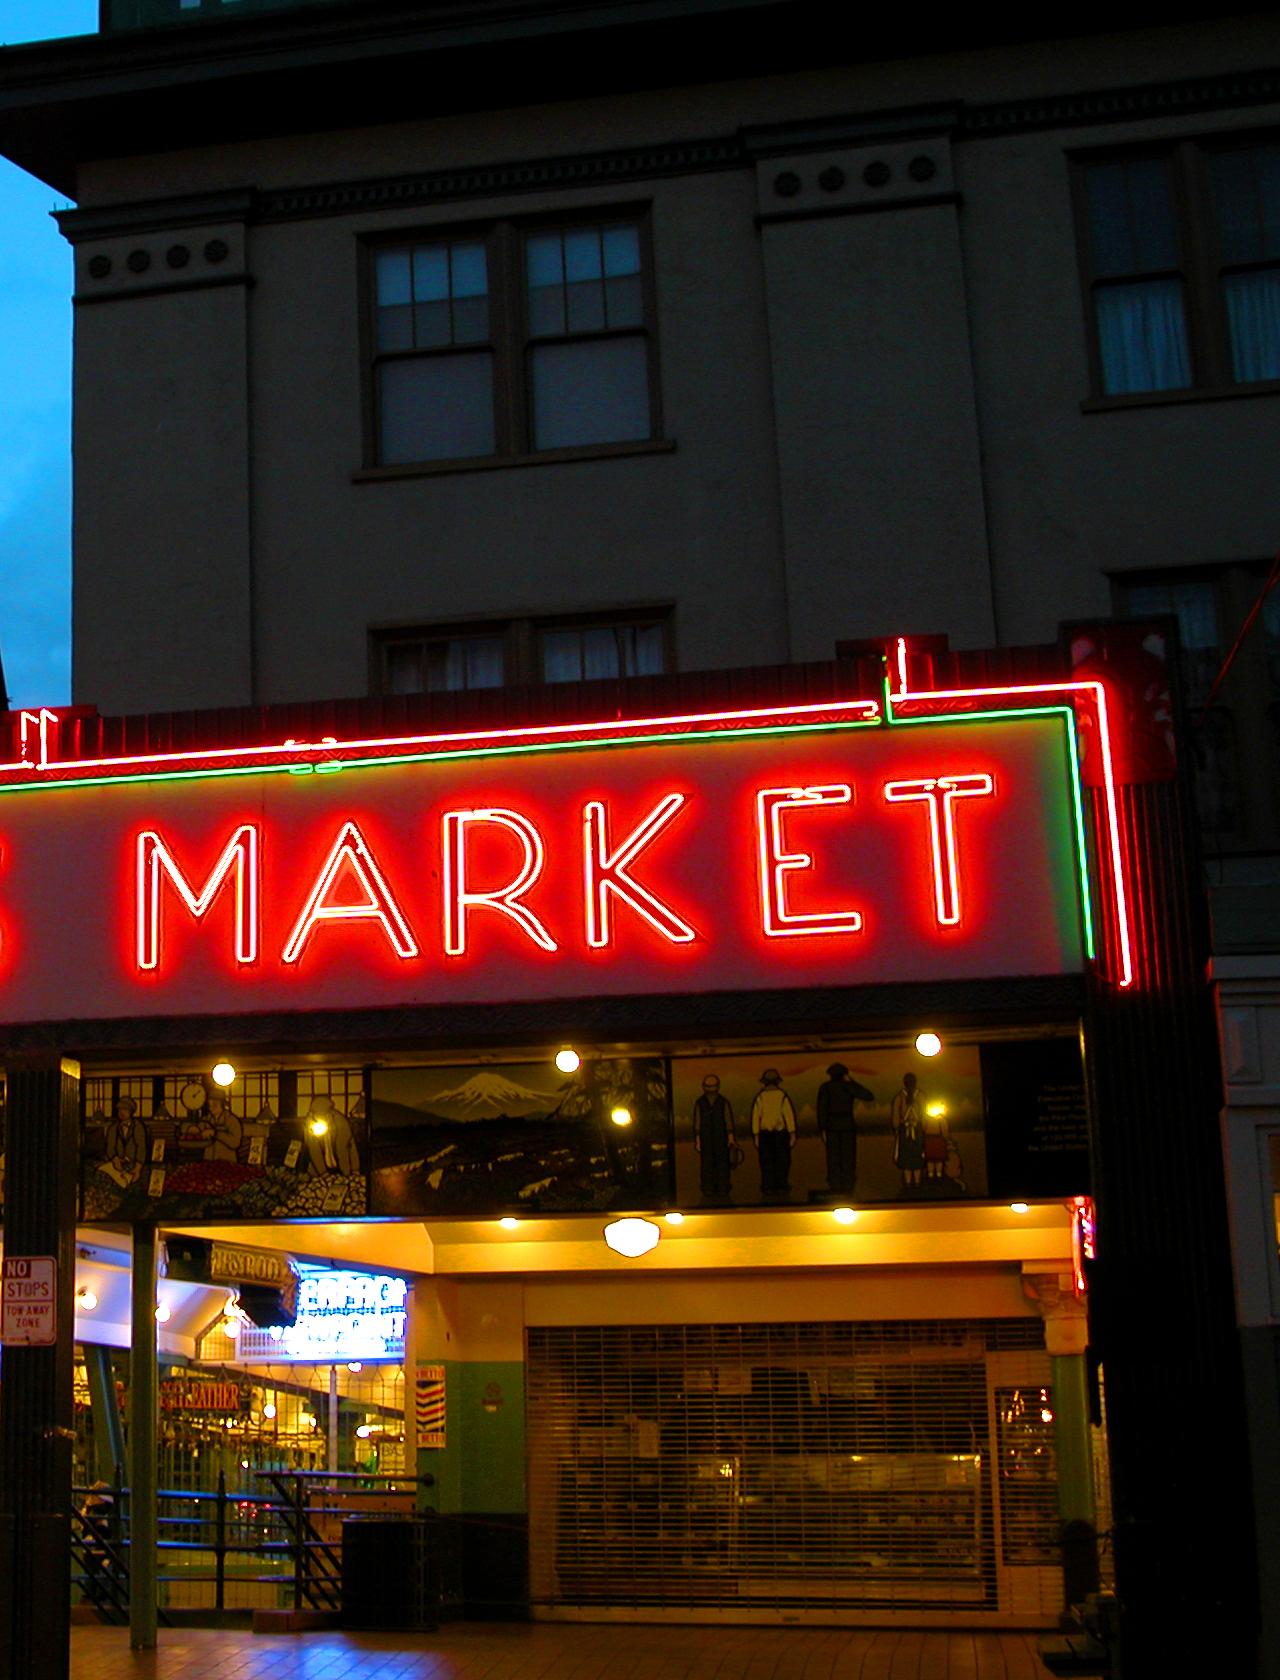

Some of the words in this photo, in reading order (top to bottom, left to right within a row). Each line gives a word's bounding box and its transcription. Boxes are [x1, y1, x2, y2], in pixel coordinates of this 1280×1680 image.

[135, 771, 998, 972] MARKET
[6, 1260, 28, 1277] NO
[7, 1281, 49, 1298] STOPS
[16, 1317, 41, 1329] ZONE
